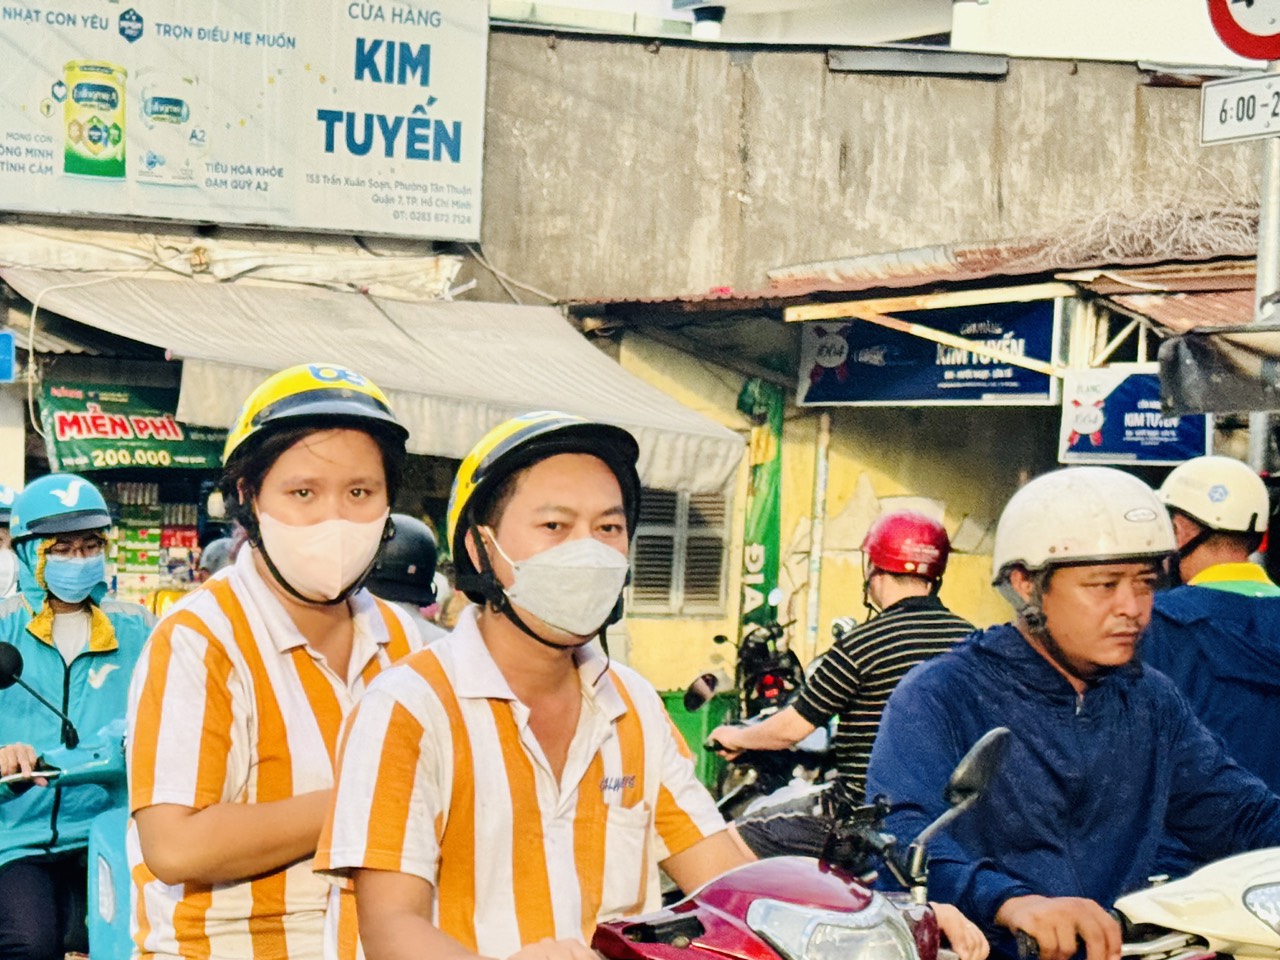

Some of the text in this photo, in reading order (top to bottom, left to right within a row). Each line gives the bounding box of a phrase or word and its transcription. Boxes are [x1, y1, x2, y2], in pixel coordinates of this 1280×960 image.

[46, 11, 76, 26] CON
[81, 14, 109, 31] YÊU
[354, 37, 431, 87] KIM
[34, 133, 53, 143] CON
[317, 95, 462, 163] TUYẾN
[25, 147, 53, 160] MINH
[256, 180, 269, 192] A2
[90, 449, 170, 467] 200.000
